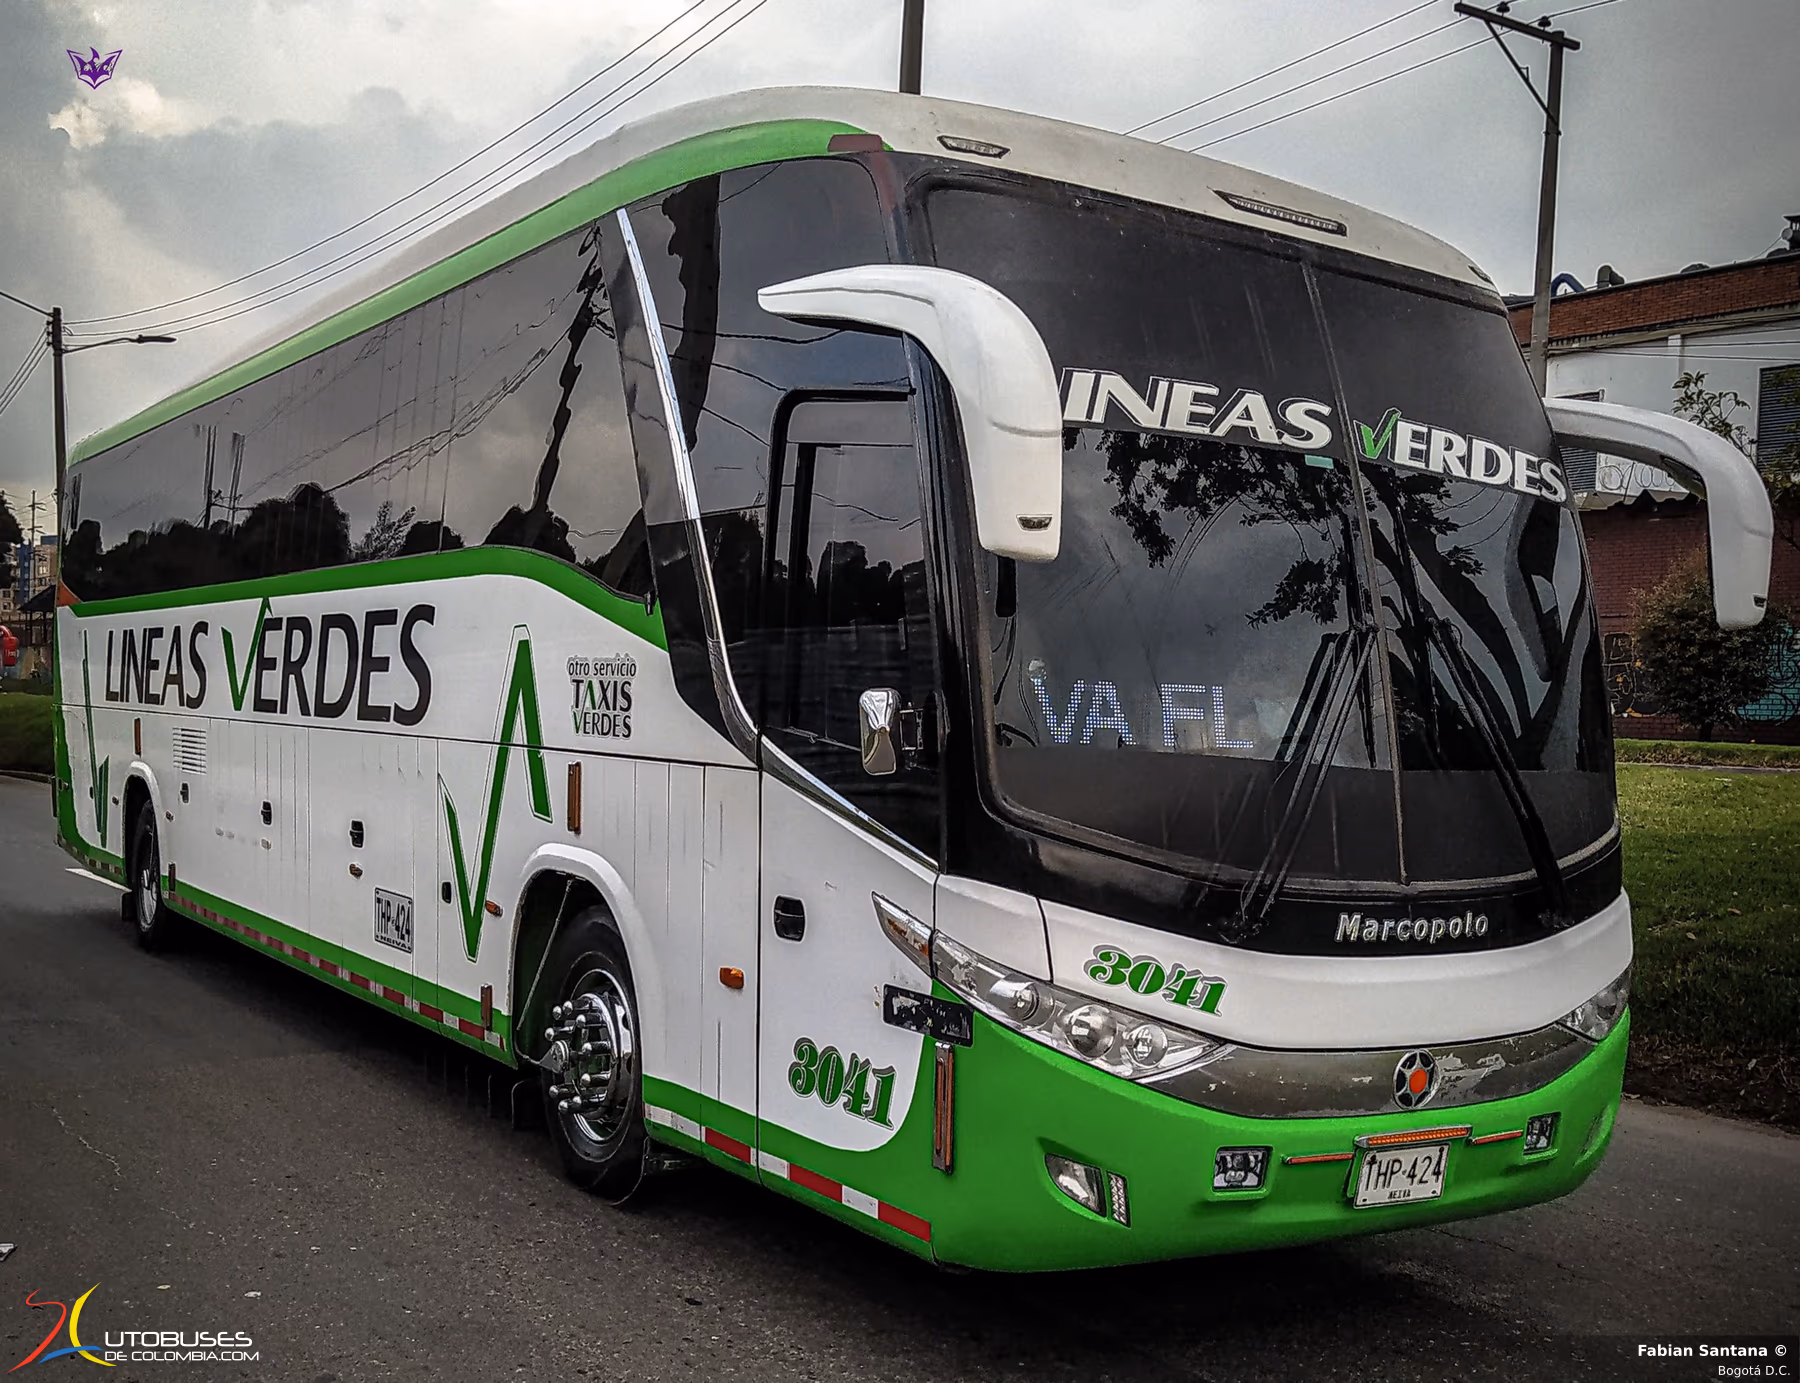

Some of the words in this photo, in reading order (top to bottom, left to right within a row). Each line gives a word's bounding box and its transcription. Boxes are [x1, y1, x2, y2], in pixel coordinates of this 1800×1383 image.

[1059, 368, 1332, 449] INEAS
[1353, 407, 1567, 503] VERDES
[105, 621, 209, 709] LINEAS
[220, 597, 436, 727] VERDES
[568, 660, 590, 676] otro
[593, 658, 637, 677] servicio
[571, 679, 632, 712] TAXIS
[573, 711, 632, 738] VERDES
[1033, 679, 1138, 746] VA
[1160, 683, 1254, 748] FL
[1336, 911, 1489, 943] Marcopolo
[1083, 944, 1228, 1017] 3041
[788, 1037, 897, 1130] 3041
